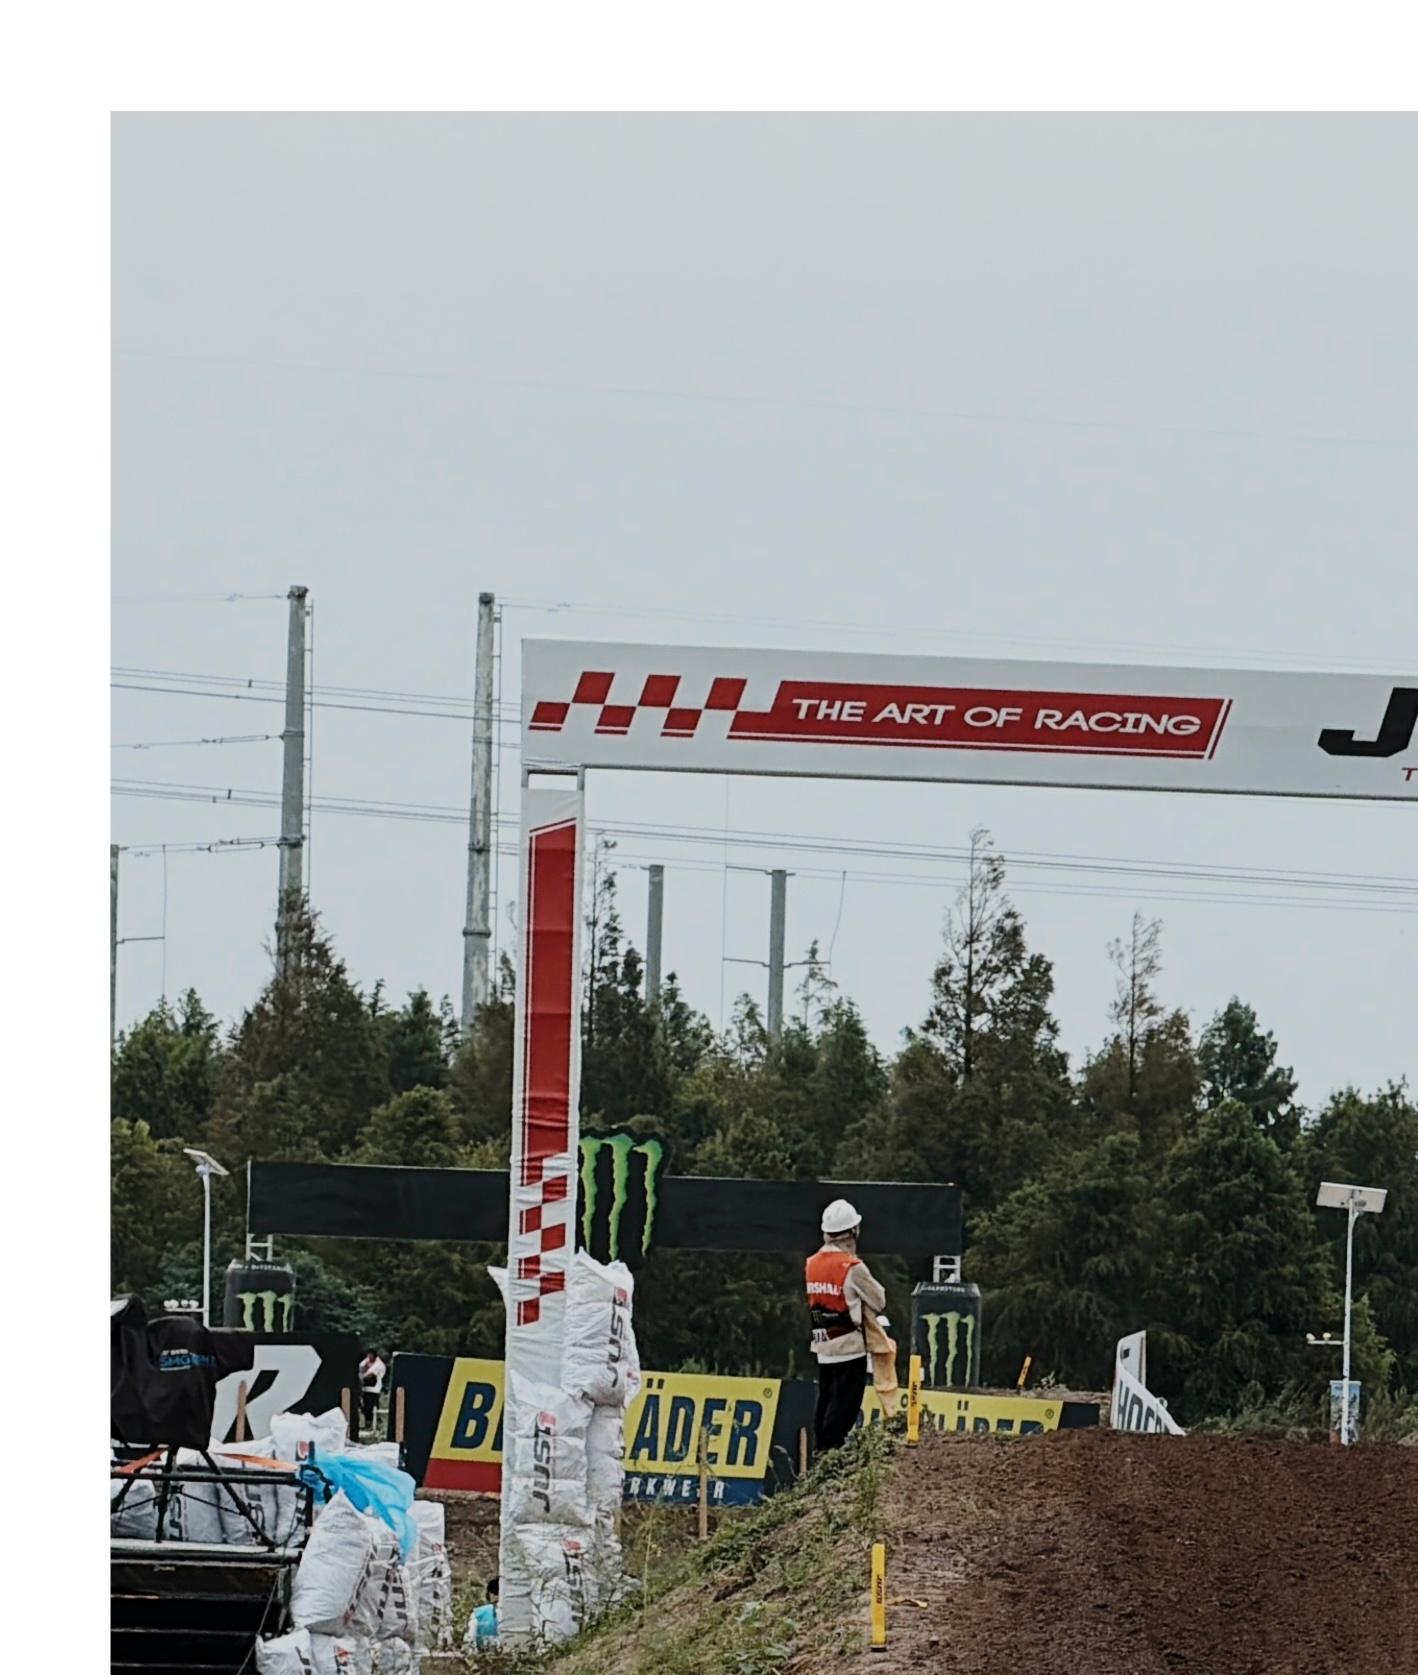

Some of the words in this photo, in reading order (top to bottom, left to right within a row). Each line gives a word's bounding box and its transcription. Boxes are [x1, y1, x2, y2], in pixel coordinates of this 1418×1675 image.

[792, 697, 866, 724] THE
[871, 702, 957, 728] ART
[967, 706, 1022, 730] OF
[1034, 709, 1202, 736] RACING
